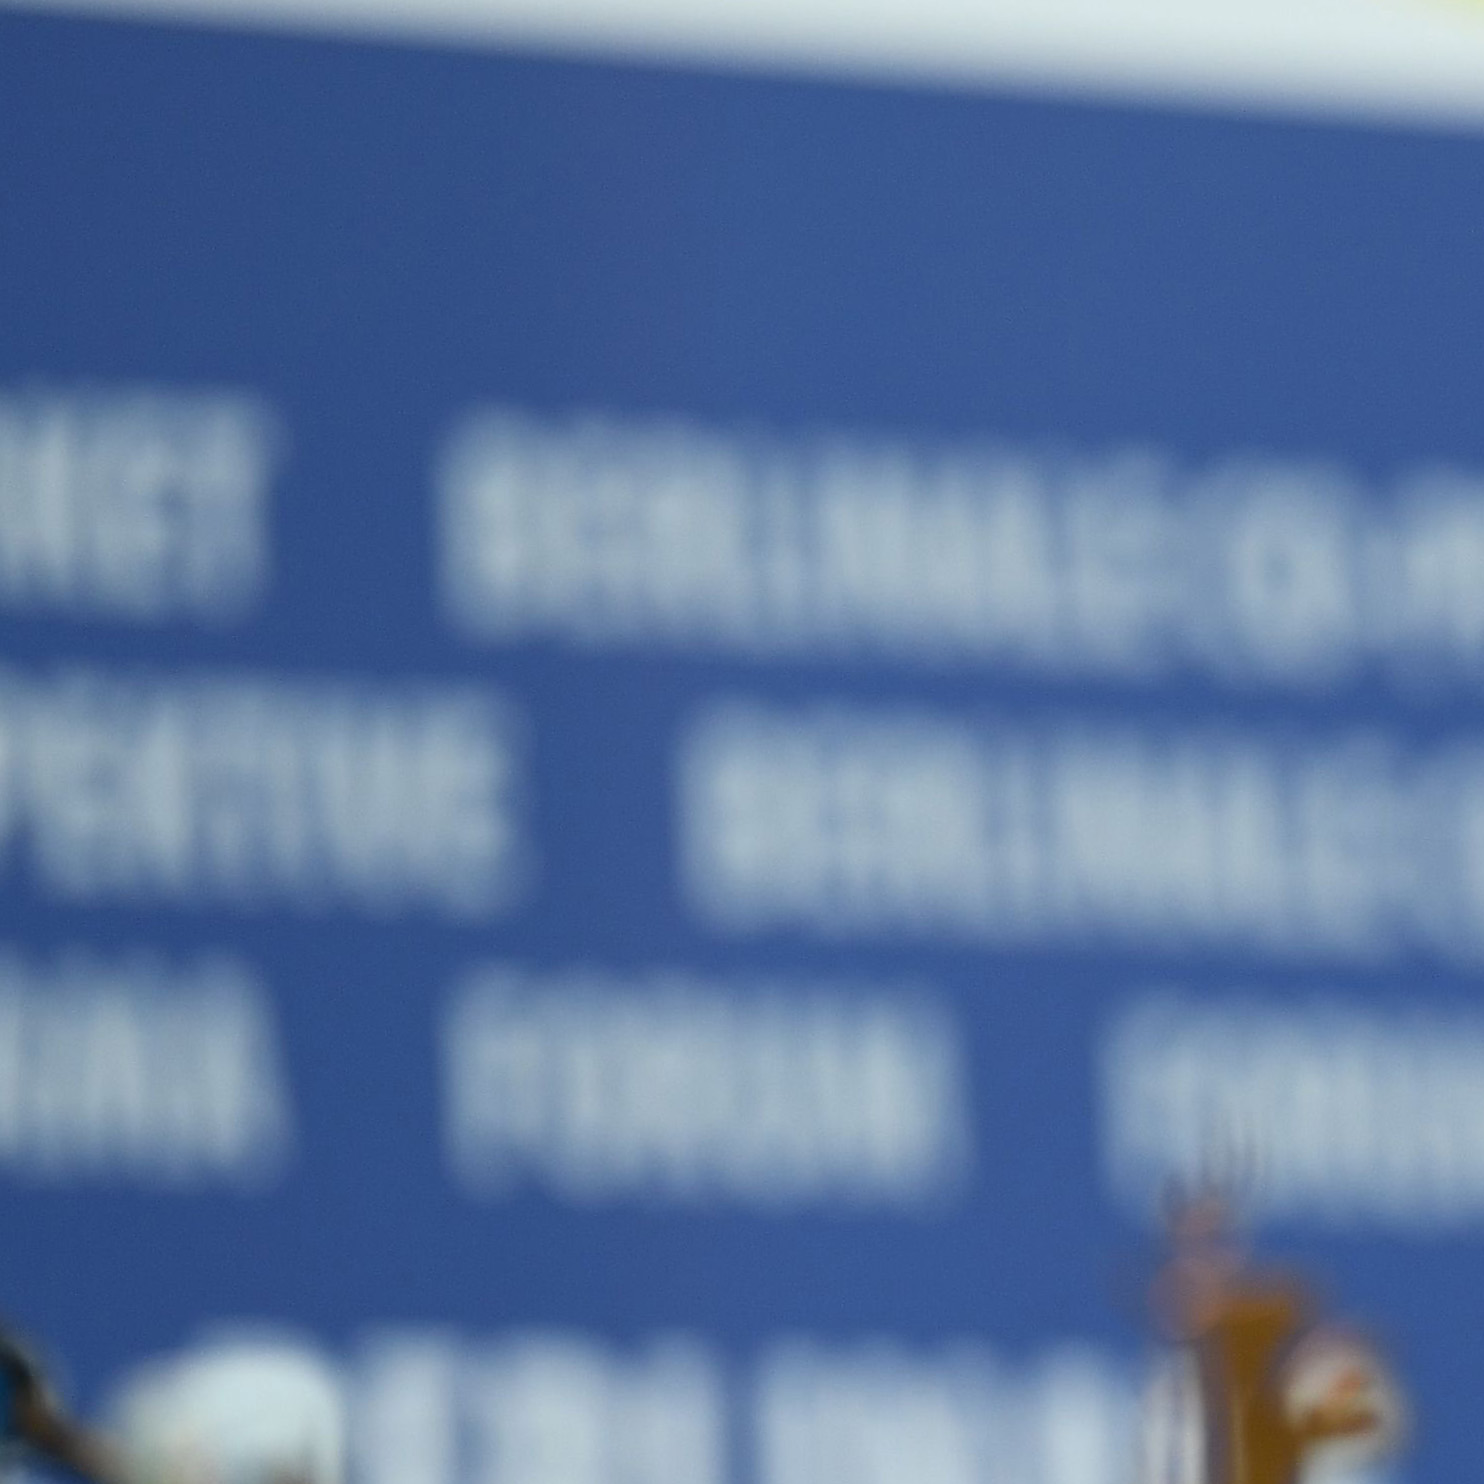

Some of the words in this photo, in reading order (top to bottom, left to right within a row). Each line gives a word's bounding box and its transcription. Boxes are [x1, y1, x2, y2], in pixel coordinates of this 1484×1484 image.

[458, 427, 1180, 658] BERLINALE
[696, 716, 1410, 940] BERLINALE
[462, 988, 954, 1194] FORUM
